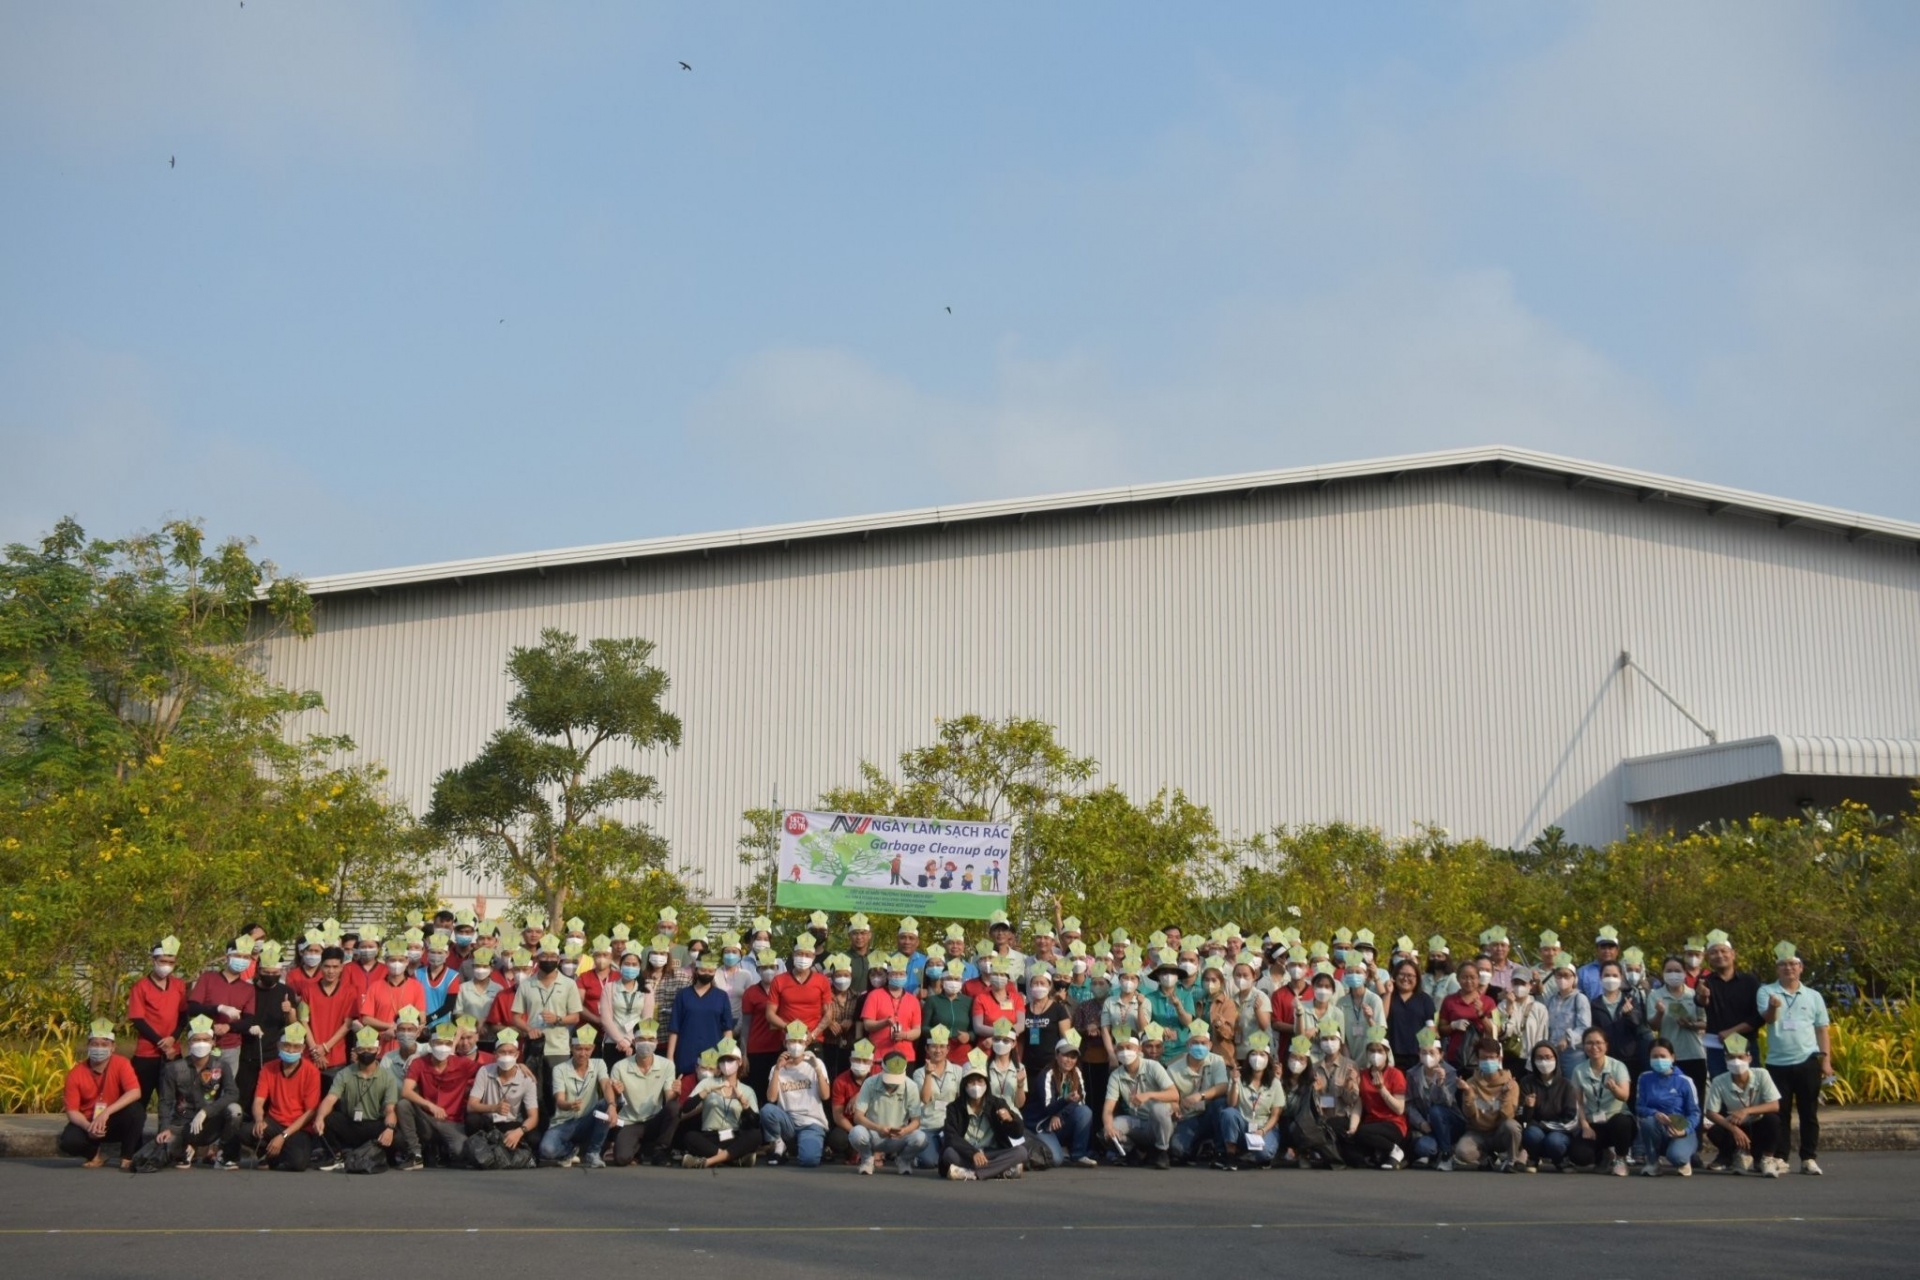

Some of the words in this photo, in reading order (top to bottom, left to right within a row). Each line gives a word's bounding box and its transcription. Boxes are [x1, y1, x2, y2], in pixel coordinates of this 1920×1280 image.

[872, 820, 909, 832] NGÀY
[912, 821, 941, 835] LÀM
[945, 825, 979, 838] SẠCH
[983, 826, 1010, 838] RÁC
[870, 838, 926, 854] Garbage
[929, 842, 981, 858] Cleanup
[984, 846, 1008, 859] day
